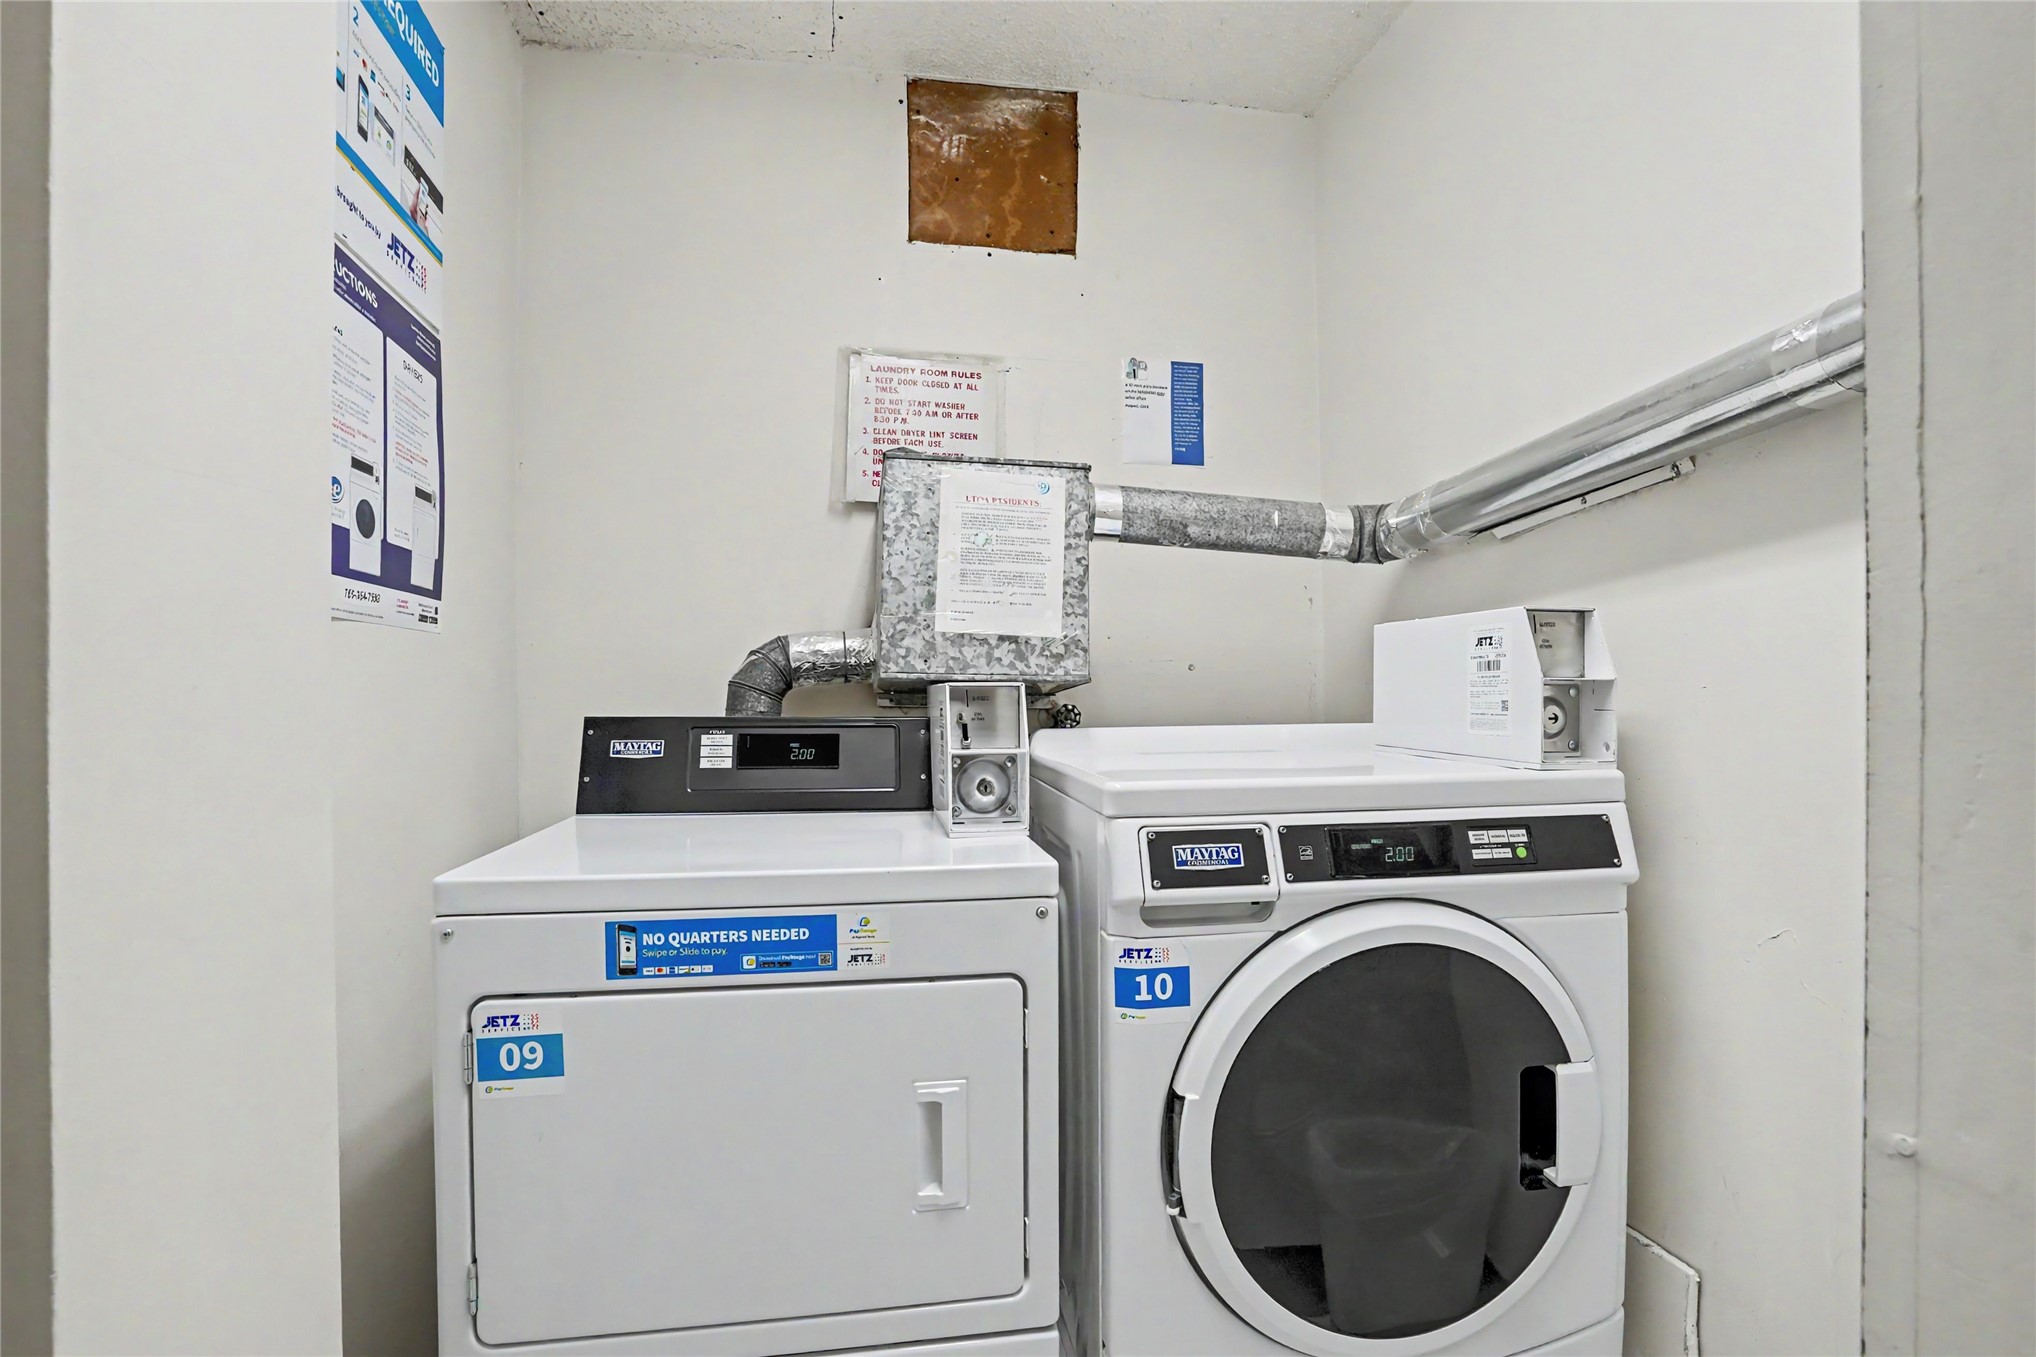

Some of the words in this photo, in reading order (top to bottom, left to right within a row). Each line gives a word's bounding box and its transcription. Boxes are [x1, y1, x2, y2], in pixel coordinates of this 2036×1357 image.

[352, 7, 359, 27] 2
[382, 0, 440, 88] EQUIRED
[405, 84, 411, 101] 3
[387, 232, 415, 273] JETZ
[334, 258, 378, 308] UCTIONS
[870, 365, 916, 375] LAUNDRY
[920, 368, 948, 377] ROOM
[951, 370, 982, 380] RULES
[875, 376, 894, 385] KEEP
[897, 378, 918, 386] DOOR
[922, 380, 950, 389] CLOSED
[953, 382, 963, 390] AT
[966, 383, 979, 391] ALL
[875, 397, 886, 405] DO
[907, 400, 931, 408] START
[934, 402, 966, 410] WASHER
[874, 407, 902, 415] BEFORE
[941, 411, 952, 419] OR
[955, 412, 979, 420] AFTER
[873, 428, 897, 436] CLEAN
[901, 429, 926, 438] DRYER
[929, 431, 946, 439] LINT
[949, 432, 978, 440] SCREEN
[873, 437, 901, 446] BEFORE
[904, 439, 924, 447] EACH
[1475, 636, 1494, 647] JETZ
[614, 742, 661, 751] MAYTAG
[790, 749, 815, 760] 2.00
[1175, 847, 1239, 862] MAYTAG
[1385, 847, 1414, 862] 2.00
[642, 933, 665, 946] NO
[668, 930, 748, 948] QUARTERS
[751, 928, 810, 942] NEEDED
[642, 947, 667, 960] Swipe
[669, 948, 677, 956] or
[679, 946, 700, 956] Slide
[701, 947, 710, 955] to
[847, 954, 873, 963] JETZ
[1119, 948, 1153, 960] JETZ
[1135, 972, 1173, 1001] 10
[481, 1014, 520, 1028] JETZ
[499, 1040, 544, 1072] 09
